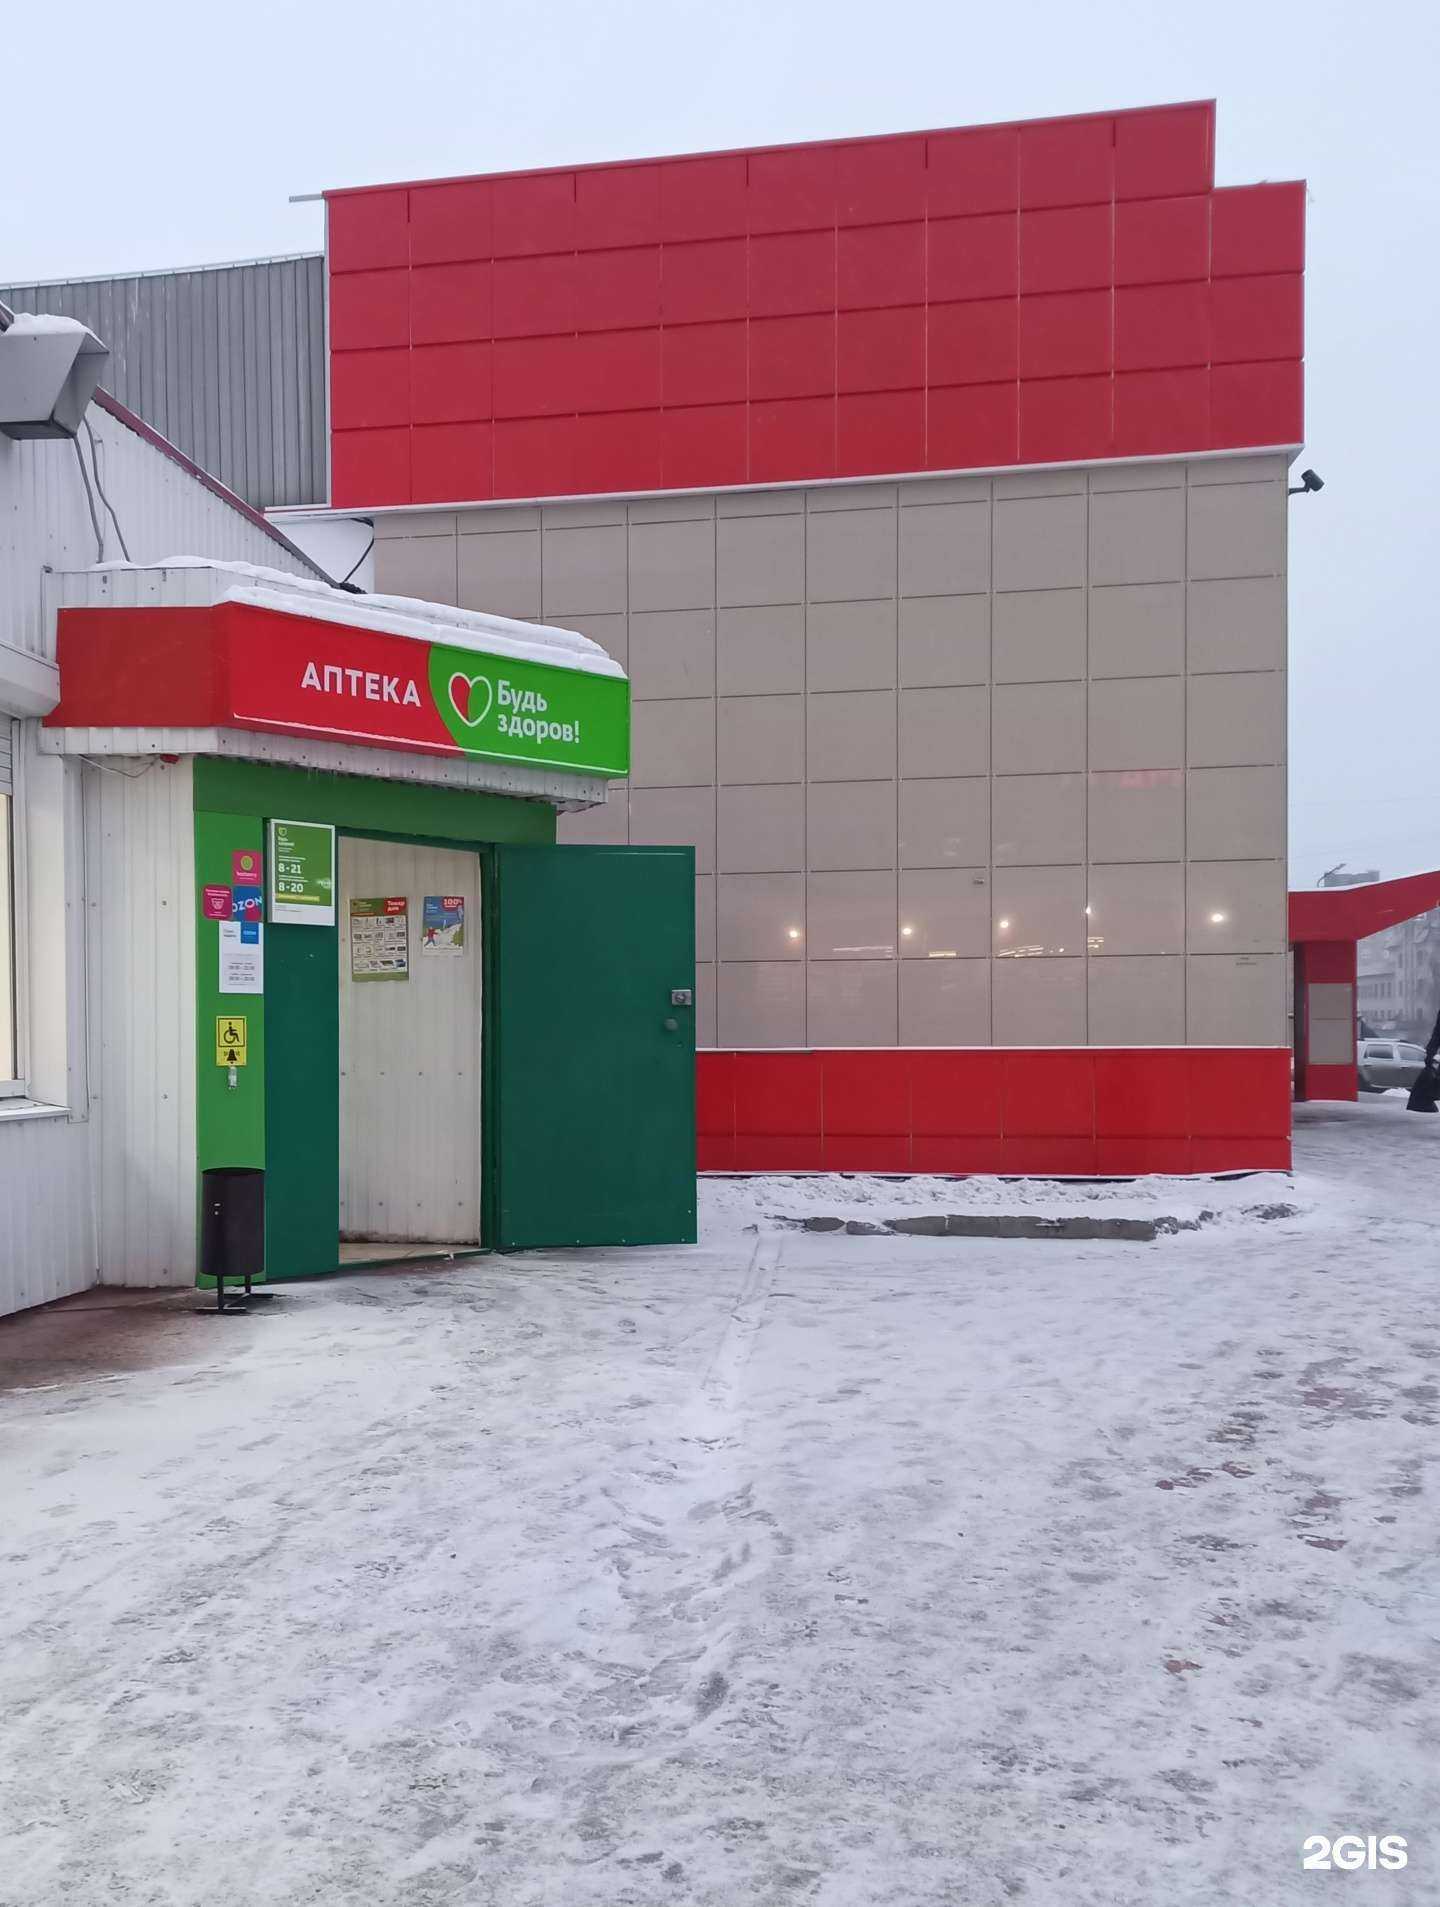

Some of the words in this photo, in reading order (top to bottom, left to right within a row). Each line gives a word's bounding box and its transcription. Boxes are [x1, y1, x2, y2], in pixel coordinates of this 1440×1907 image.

[301, 661, 422, 708] АПТЕКА
[497, 679, 548, 714] Будь
[497, 713, 580, 745] здоров!
[232, 896, 263, 912] OZON
